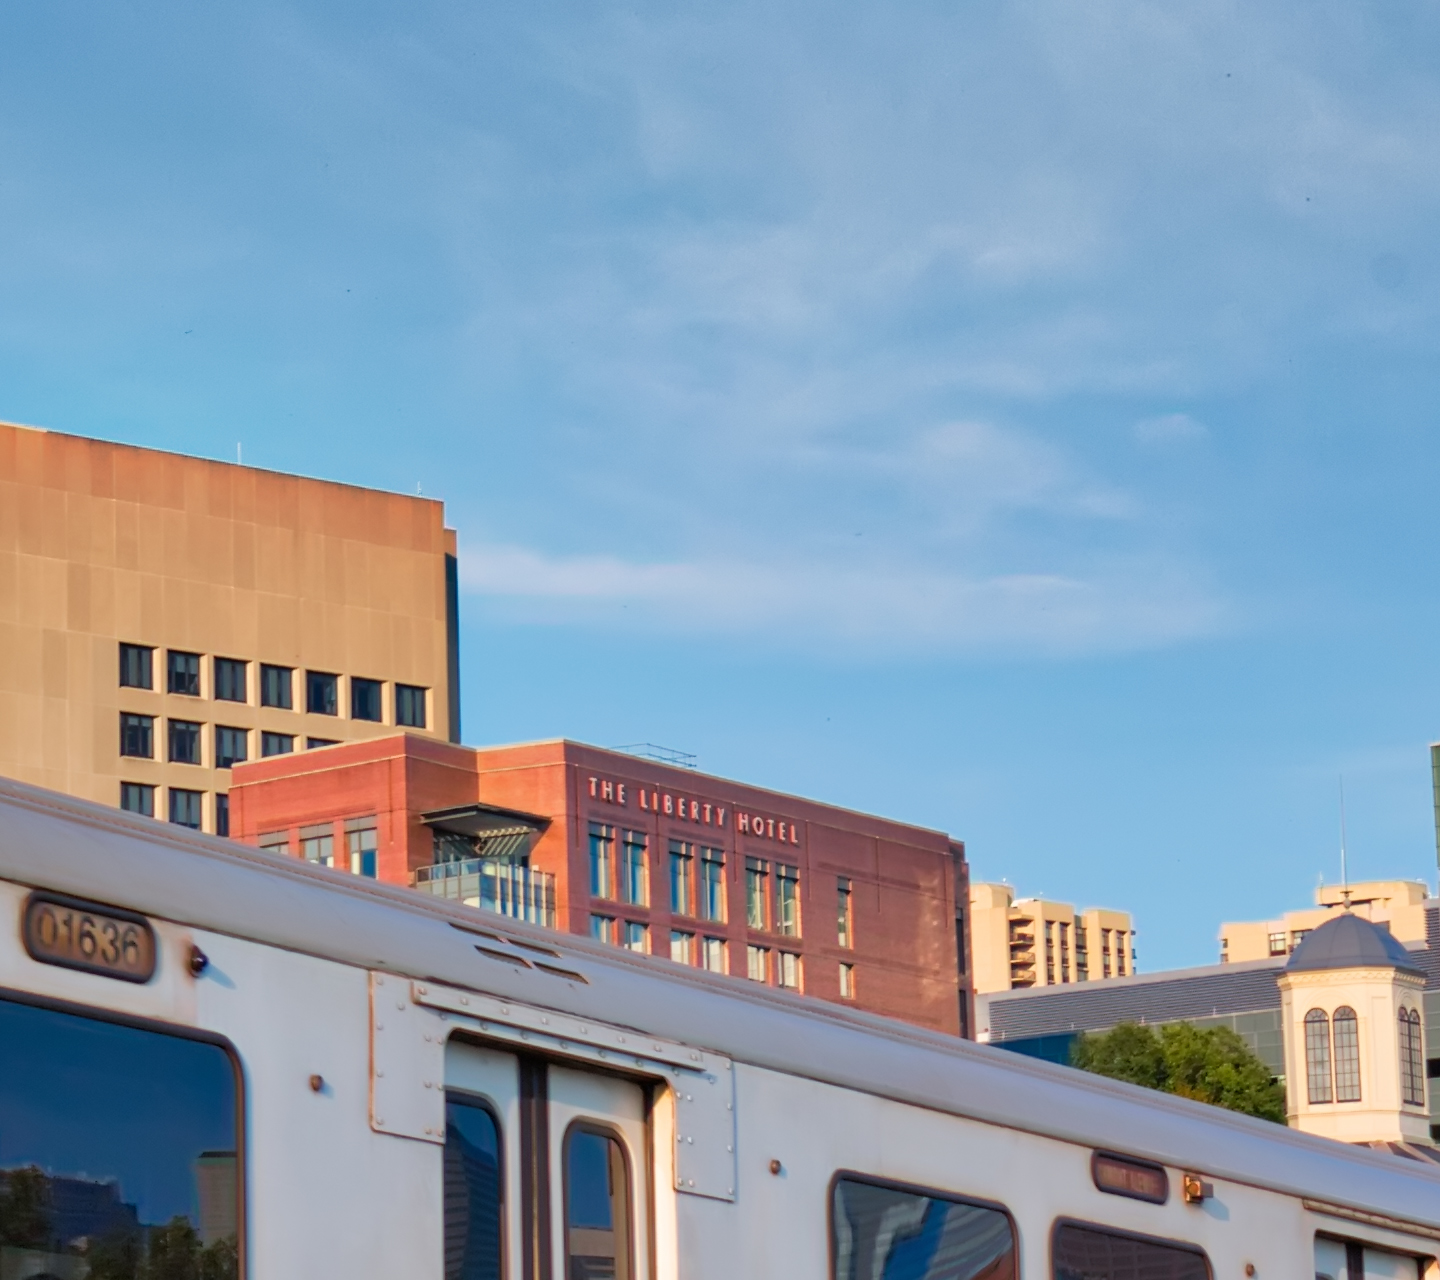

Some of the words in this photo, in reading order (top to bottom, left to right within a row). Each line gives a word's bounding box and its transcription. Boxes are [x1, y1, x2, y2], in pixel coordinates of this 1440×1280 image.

[588, 776, 626, 804] THE
[639, 788, 725, 826] LIBERTY
[738, 812, 799, 844] HOTEL
[39, 907, 140, 966] 01636
